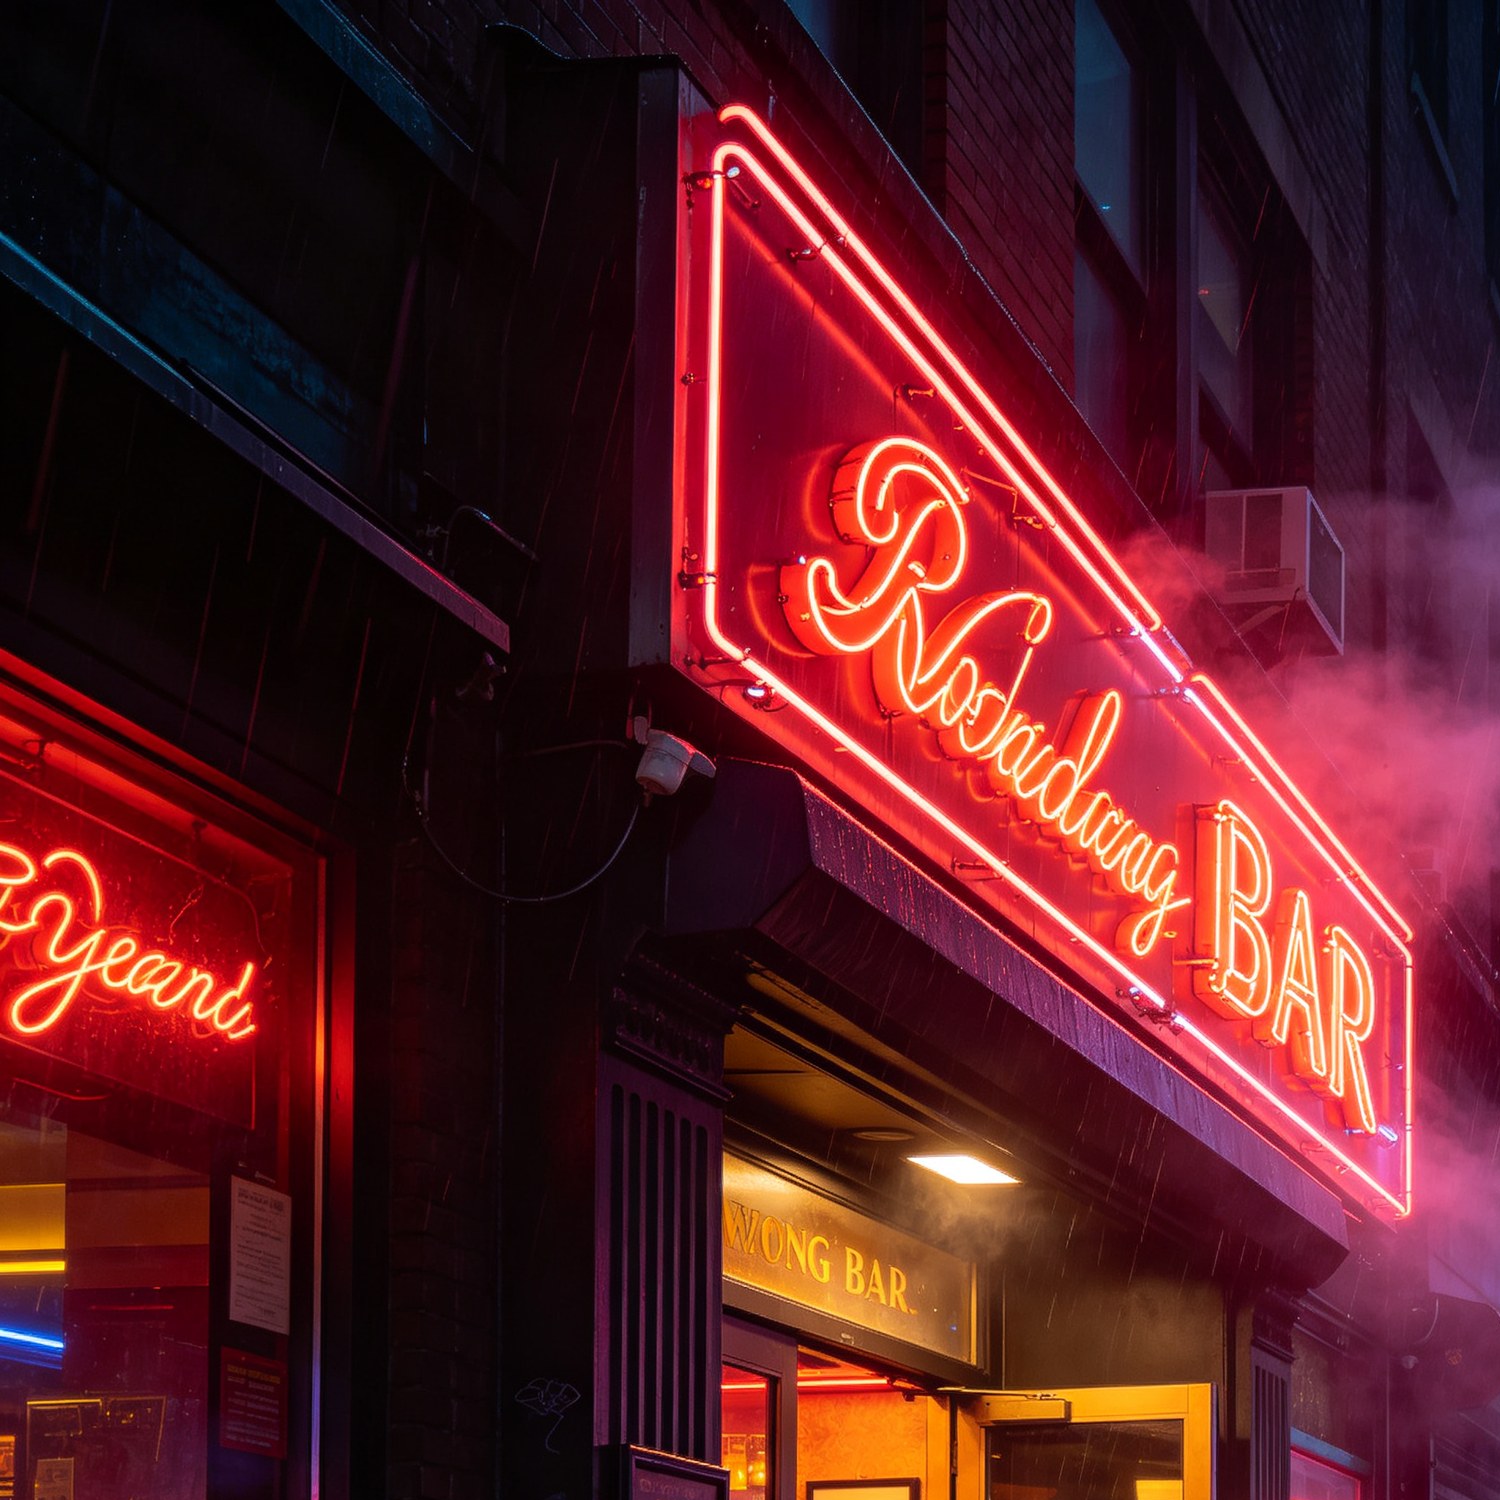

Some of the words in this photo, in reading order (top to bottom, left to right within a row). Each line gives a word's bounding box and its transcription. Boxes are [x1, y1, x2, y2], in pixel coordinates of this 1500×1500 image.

[1212, 799, 1377, 1134] BAR
[723, 1199, 831, 1285] WONG
[845, 1247, 918, 1315] BAR
